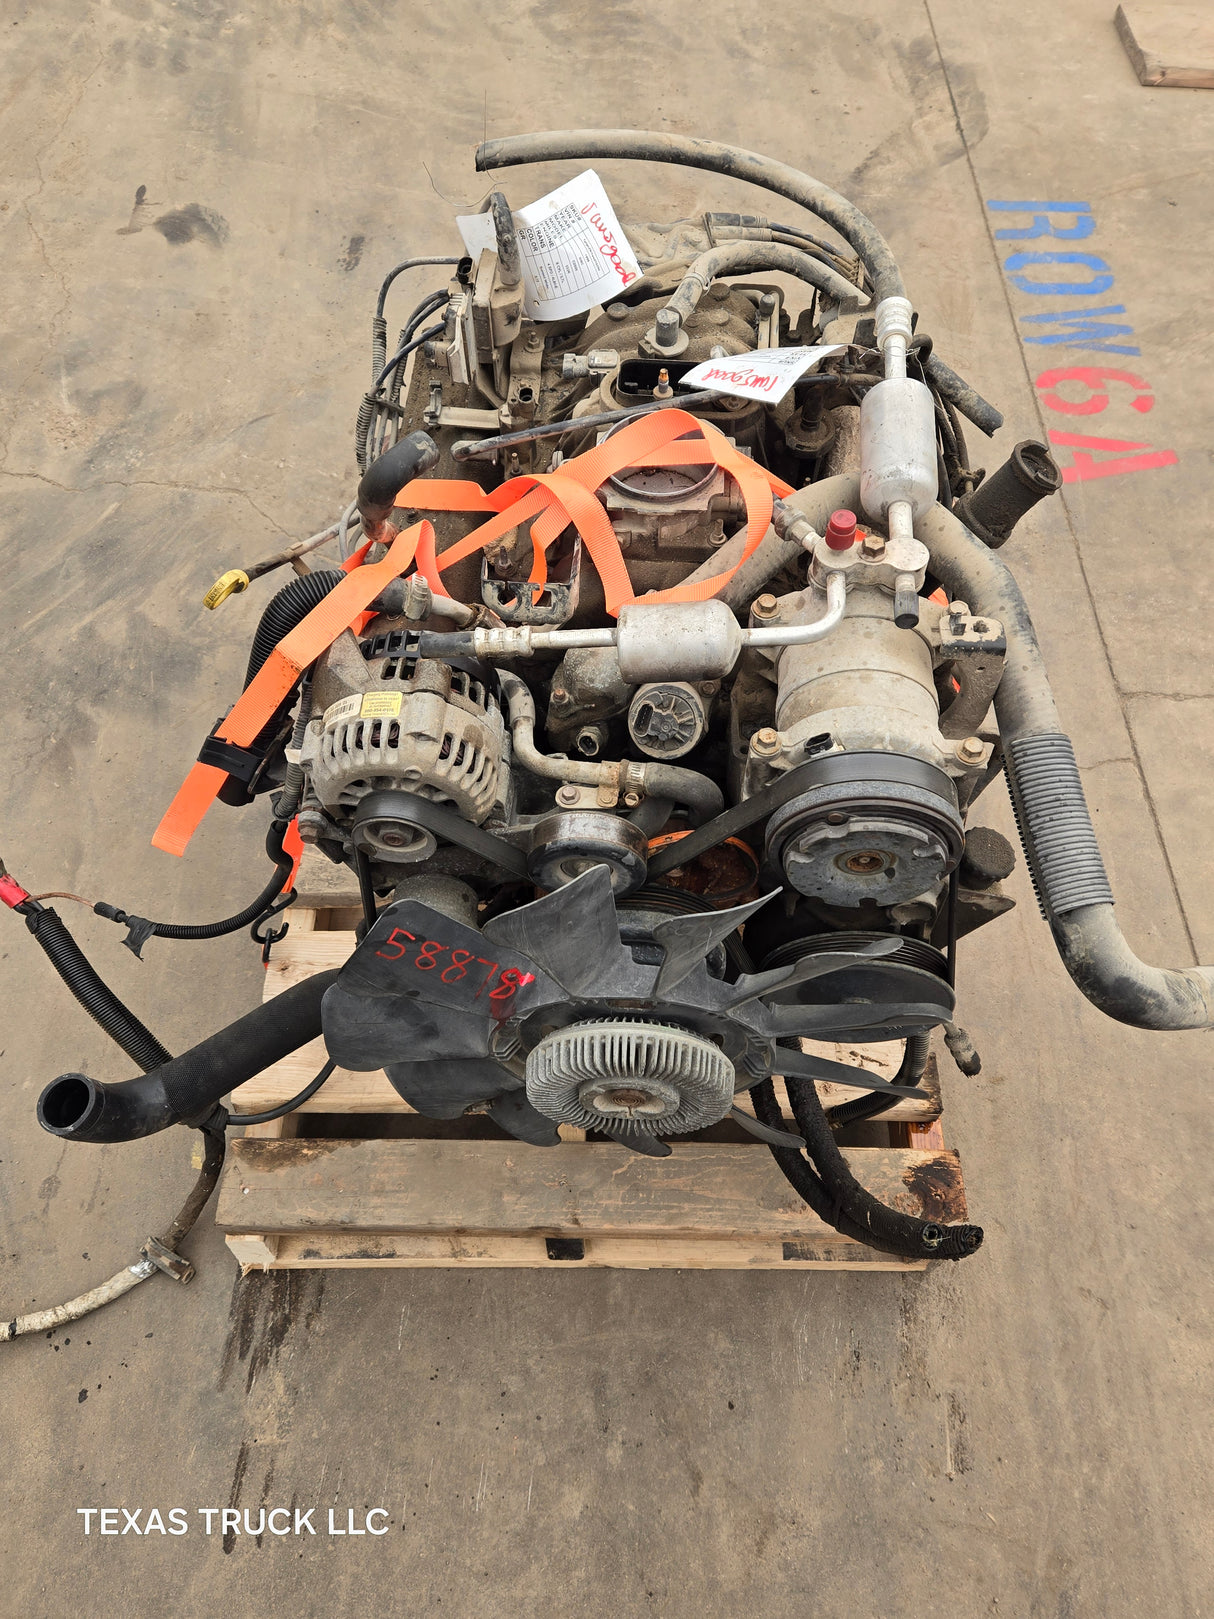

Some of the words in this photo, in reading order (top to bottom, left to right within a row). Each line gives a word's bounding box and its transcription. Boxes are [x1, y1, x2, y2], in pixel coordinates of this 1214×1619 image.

[549, 217, 563, 239] MODEL
[554, 214, 566, 232] MAKE
[560, 211, 571, 229] YEAR
[527, 228, 539, 252] COLOR
[535, 226, 547, 249] TRANS
[540, 223, 555, 248] ENGINE
[600, 244, 636, 287] good
[986, 199, 1142, 357] ROW
[1035, 366, 1179, 484] 6A
[375, 927, 536, 1000] 58878
